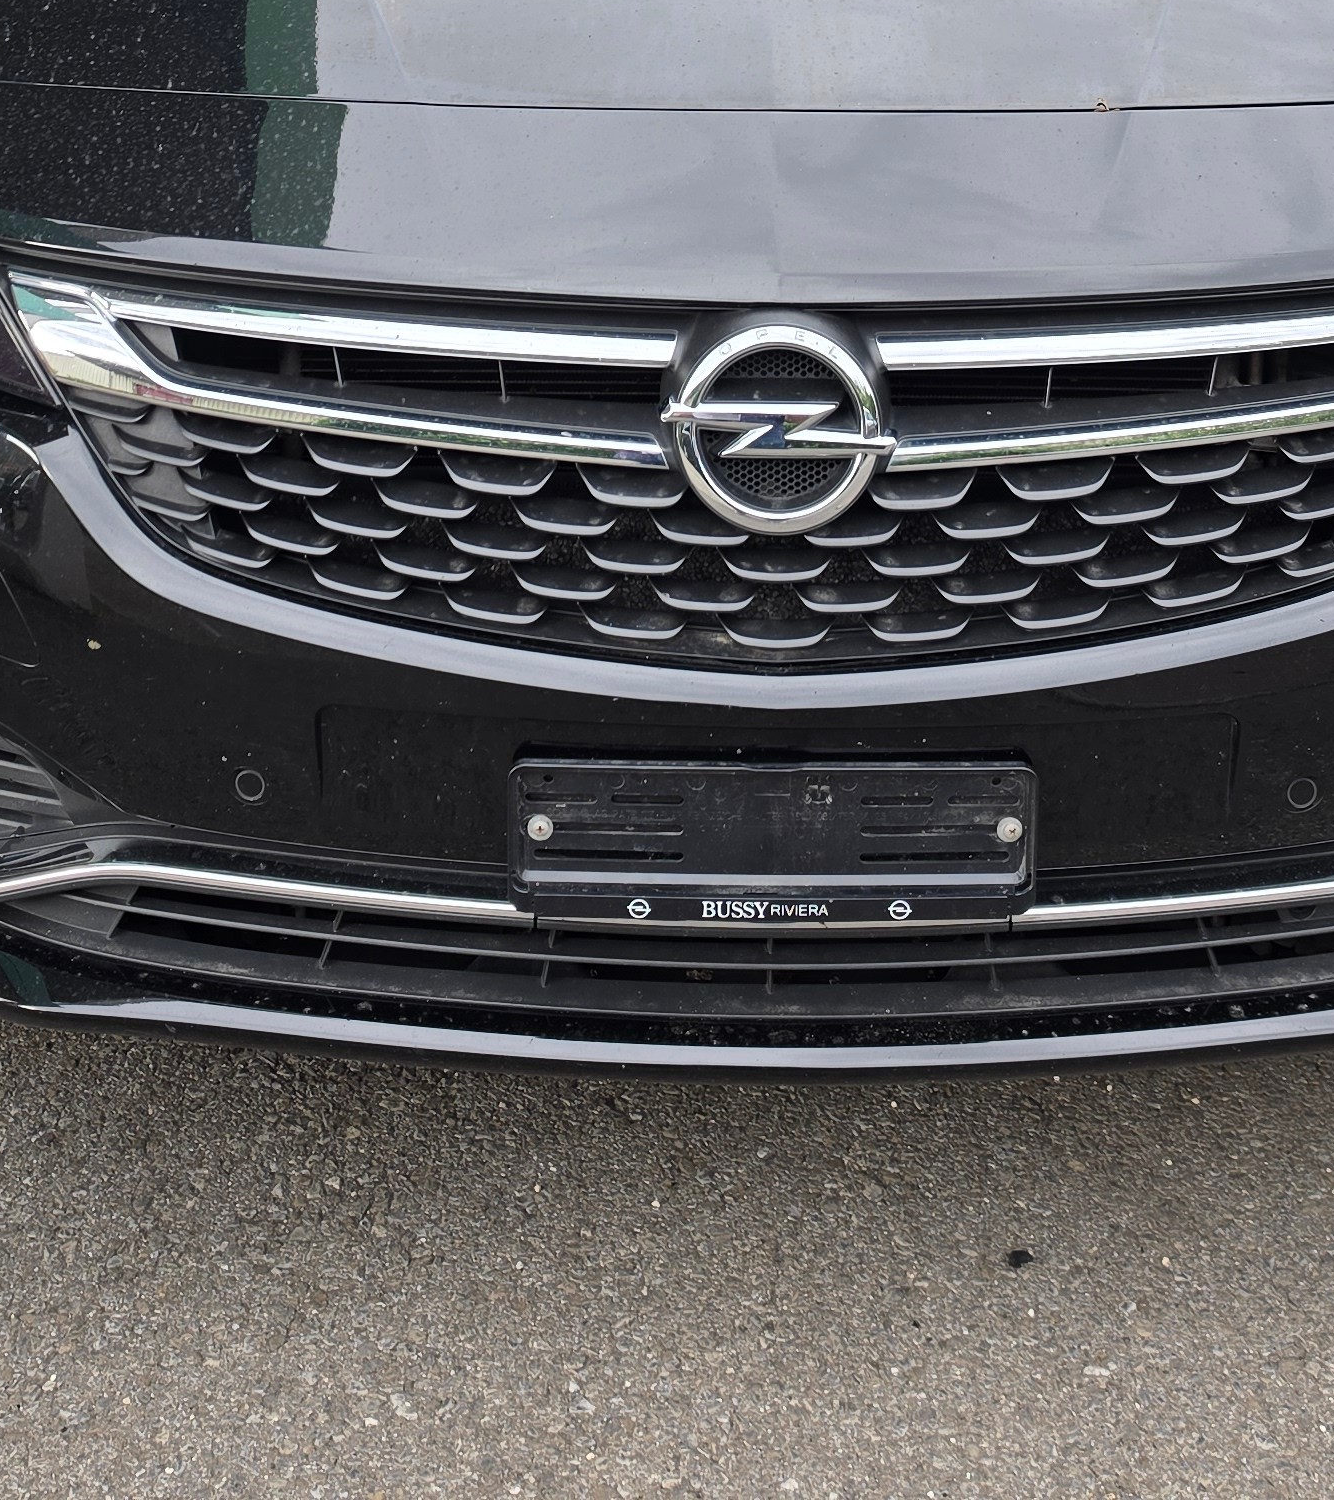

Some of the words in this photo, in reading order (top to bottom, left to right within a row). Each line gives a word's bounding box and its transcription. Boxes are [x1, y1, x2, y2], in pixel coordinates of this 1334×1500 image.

[720, 329, 838, 360] OPEL
[702, 901, 769, 918] BUSSY
[770, 904, 828, 917] RIVIERA
